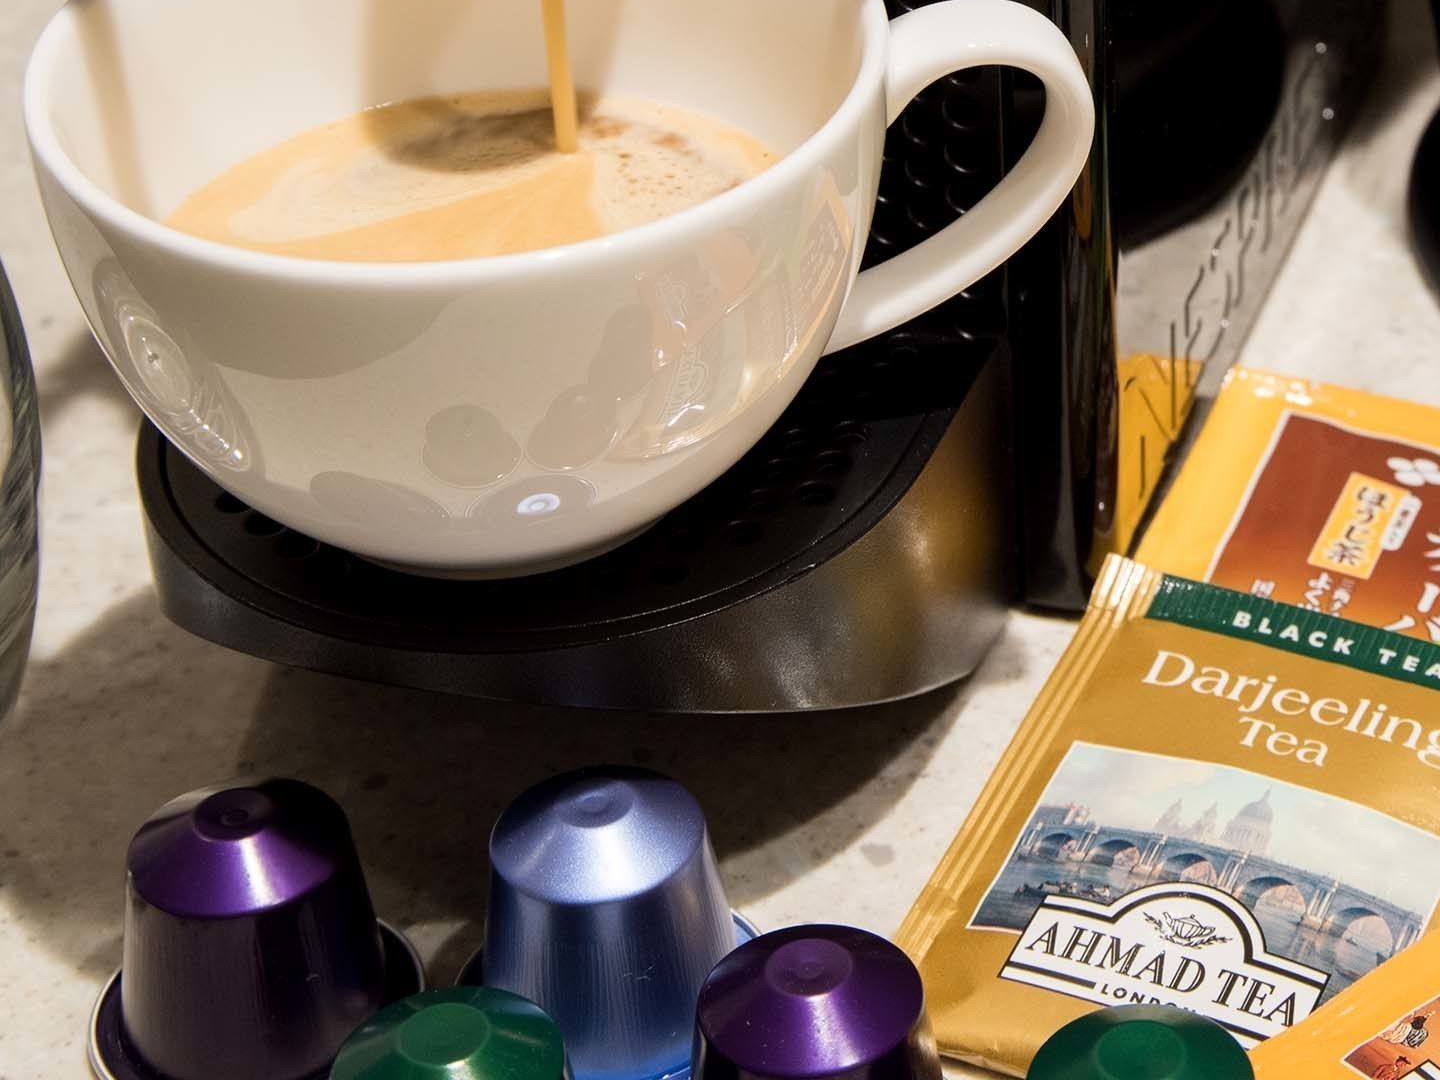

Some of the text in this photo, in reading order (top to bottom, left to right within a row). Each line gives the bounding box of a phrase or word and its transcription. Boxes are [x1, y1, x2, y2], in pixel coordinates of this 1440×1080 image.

[1325, 485, 1389, 567] ほうじ茶
[1232, 610, 1357, 656] BLACK
[1236, 716, 1330, 767] Tea
[1024, 920, 1299, 1027] AHMAD TEA
